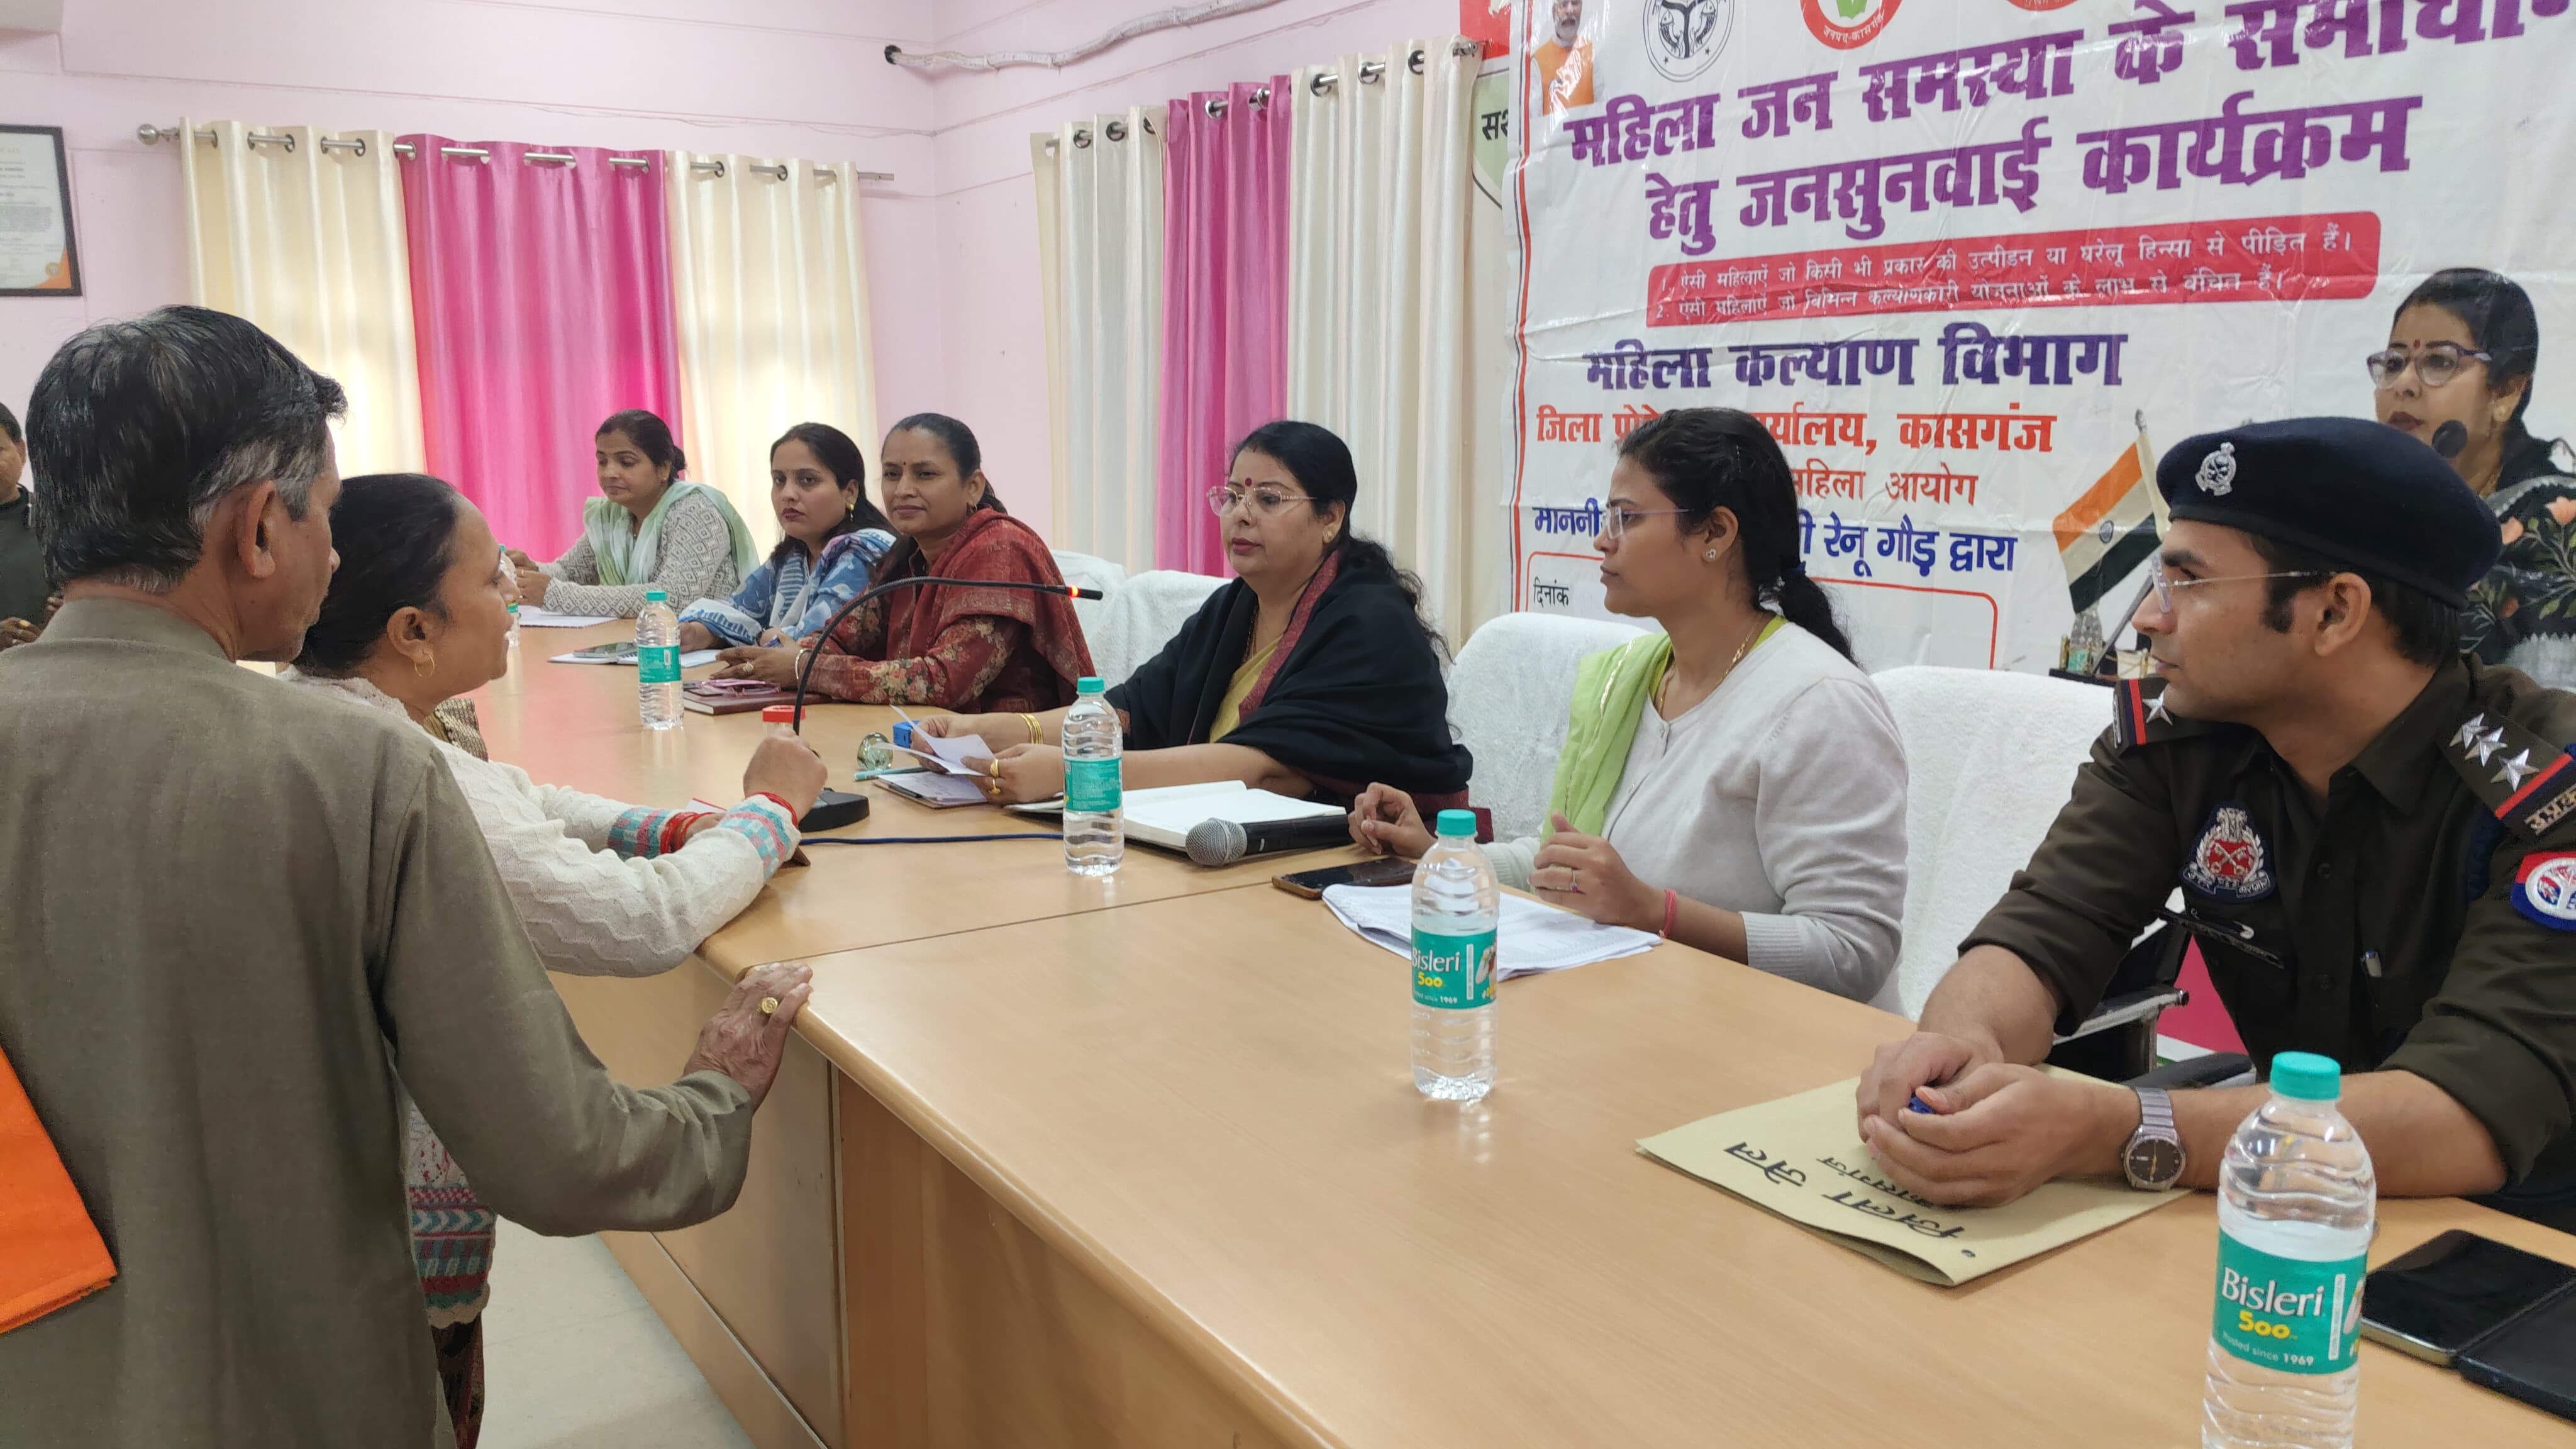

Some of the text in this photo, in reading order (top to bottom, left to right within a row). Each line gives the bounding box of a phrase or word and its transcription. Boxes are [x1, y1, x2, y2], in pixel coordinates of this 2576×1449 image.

[1563, 0, 2570, 167] महिला जन समस्या के समाधा
[1645, 91, 2423, 256] हेतु जनसुनवाई कार्यक्रम
[1680, 269, 1707, 296] ऐसी
[1779, 262, 1797, 282] जो
[1806, 257, 1842, 280] किसी
[1854, 255, 1872, 277] भी
[1884, 256, 1925, 276] प्रकार
[1936, 248, 1957, 272] की
[2046, 247, 2067, 265] या
[2080, 237, 2124, 267] घरेलू
[2139, 235, 2191, 260] हिन्सा
[2207, 230, 2224, 257] से
[1777, 291, 1796, 313] जो
[2149, 268, 2168, 293] से
[1583, 322, 2128, 390] महिला कल्याण विभाग
[1536, 404, 1602, 443] जिला
[1897, 402, 2057, 452] कासगंज
[1886, 462, 1978, 506] आयोग
[1532, 497, 1607, 537] माननी
[1824, 511, 1872, 577] रेनू
[1877, 514, 1940, 577] गौड़
[1949, 532, 2018, 572] द्वारा
[1533, 577, 1569, 608] दिनांक
[1412, 947, 1460, 972] Bisleri
[1418, 972, 1443, 988] 500
[2221, 1266, 2325, 1317] Bisleri
[2238, 1309, 2290, 1340] 500
[2283, 1352, 2314, 1367] 1969
